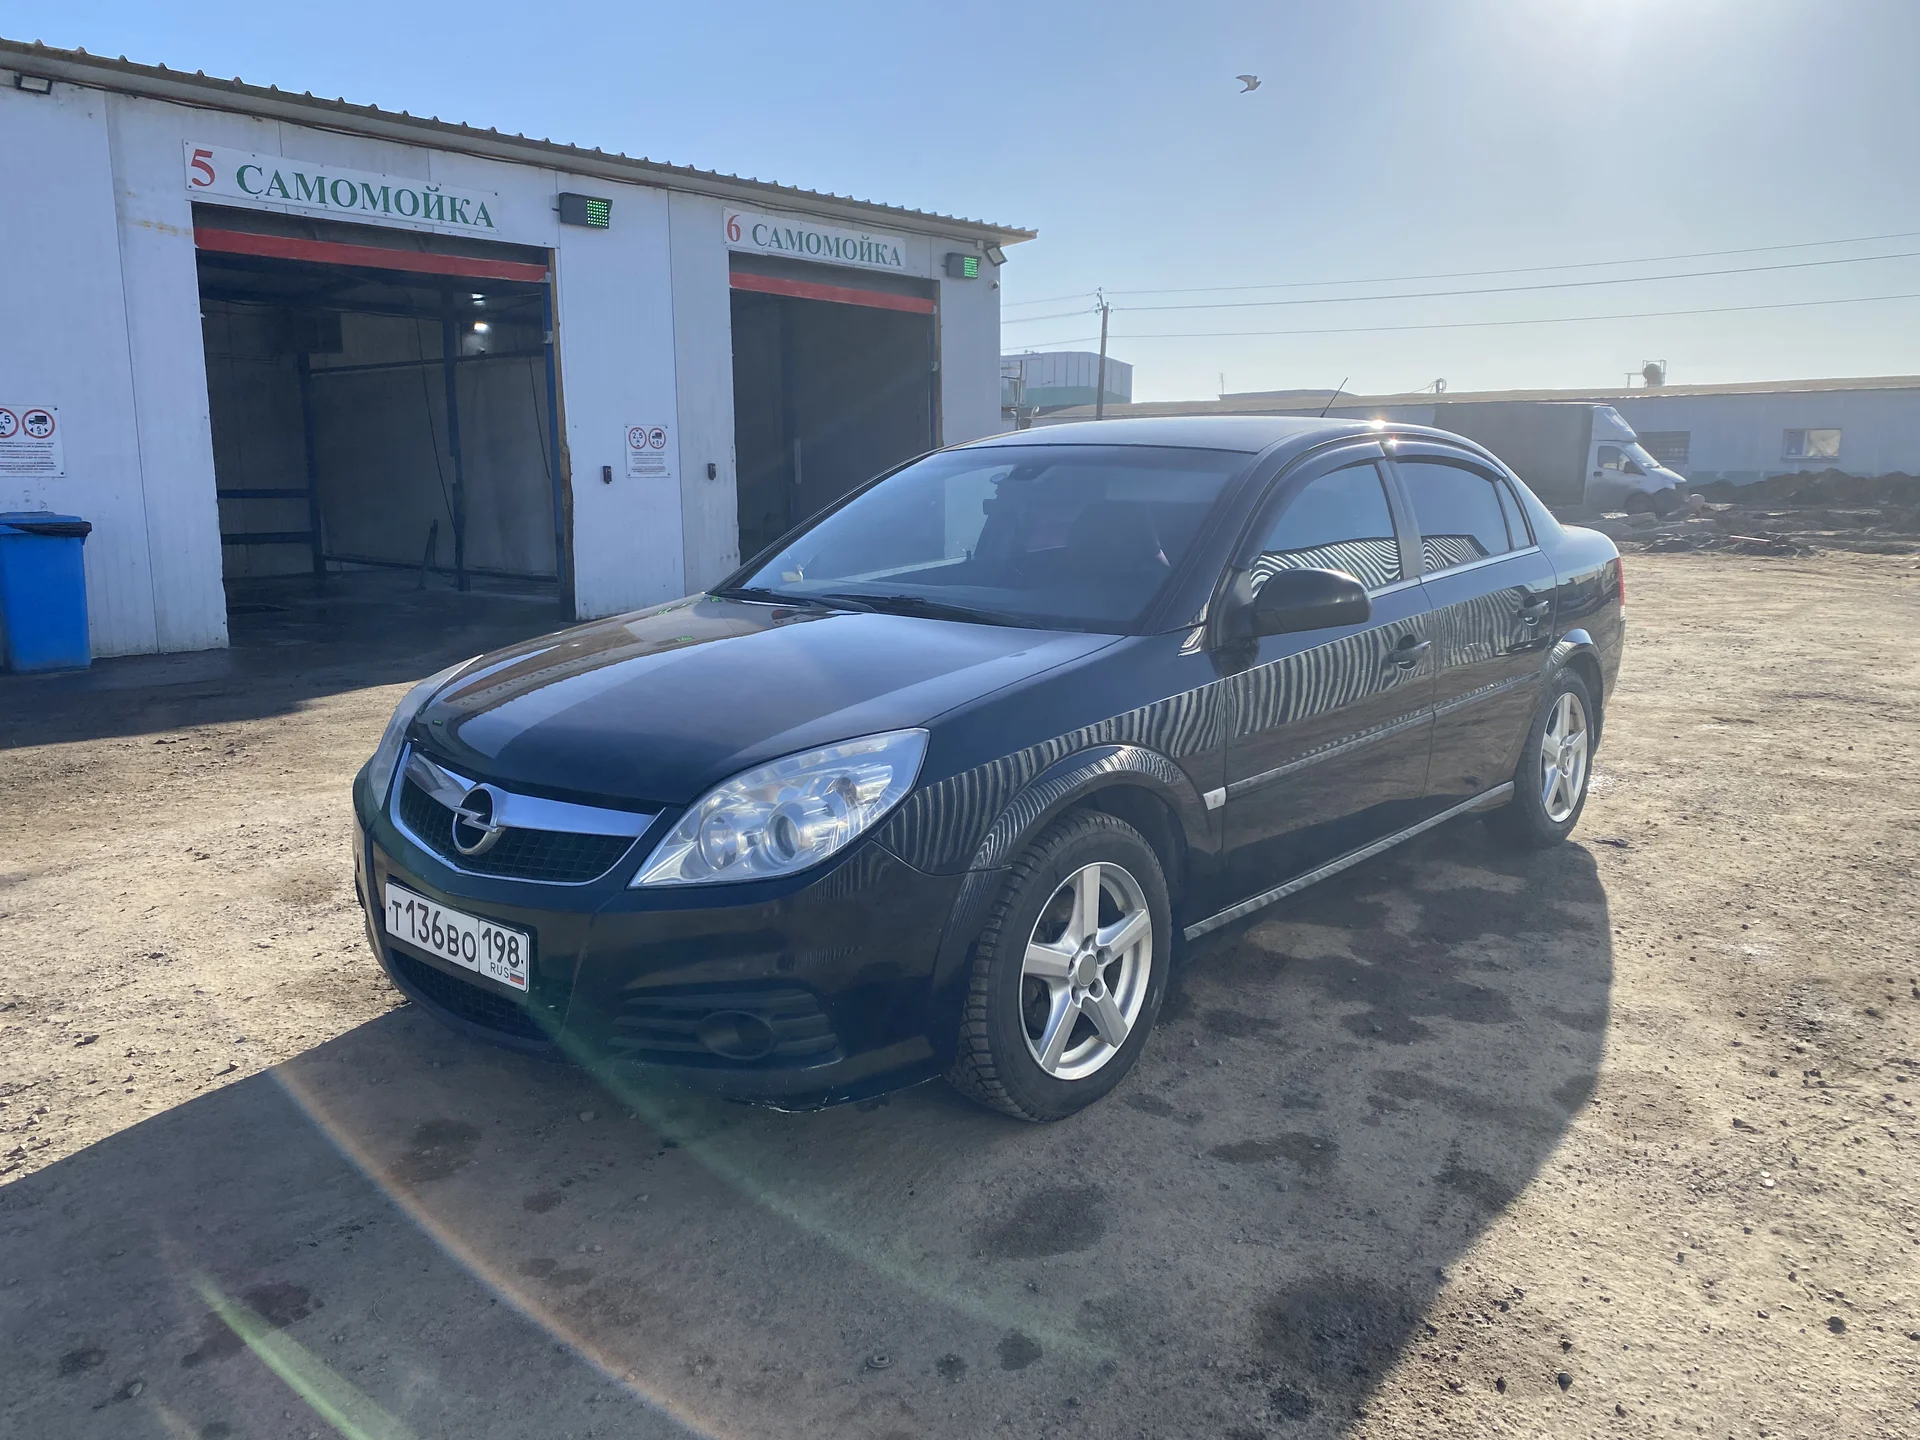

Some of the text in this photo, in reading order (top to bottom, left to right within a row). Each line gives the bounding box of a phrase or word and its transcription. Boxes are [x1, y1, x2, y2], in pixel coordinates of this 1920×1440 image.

[190, 148, 496, 229] 5 САМОМОЙКА
[727, 214, 902, 267] 6 САМОМОЙКА
[490, 962, 510, 979] RUS
